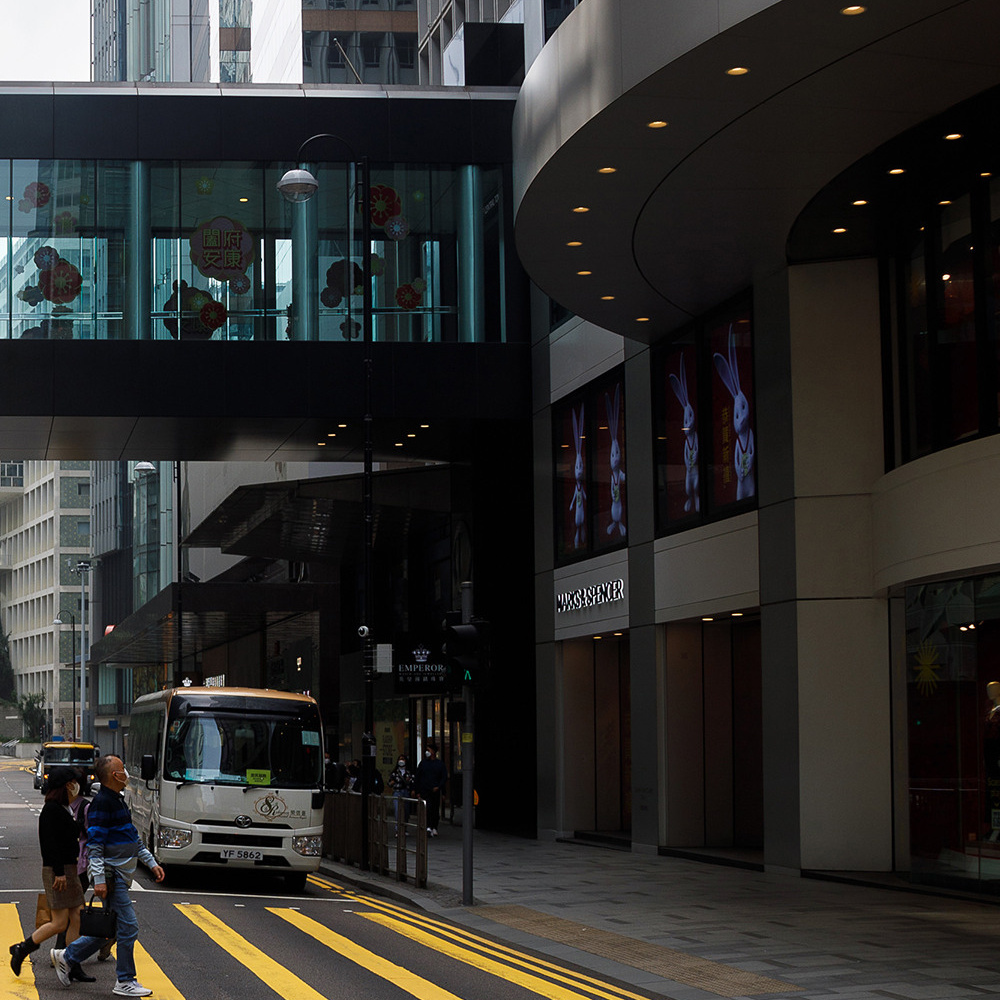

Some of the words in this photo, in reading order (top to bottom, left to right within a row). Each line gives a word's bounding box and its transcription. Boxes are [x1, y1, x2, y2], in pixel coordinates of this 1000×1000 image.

[202, 249, 242, 269] 安康
[398, 663, 444, 673] EMPEROR
[223, 849, 235, 858] YF
[237, 850, 261, 860] 5862
